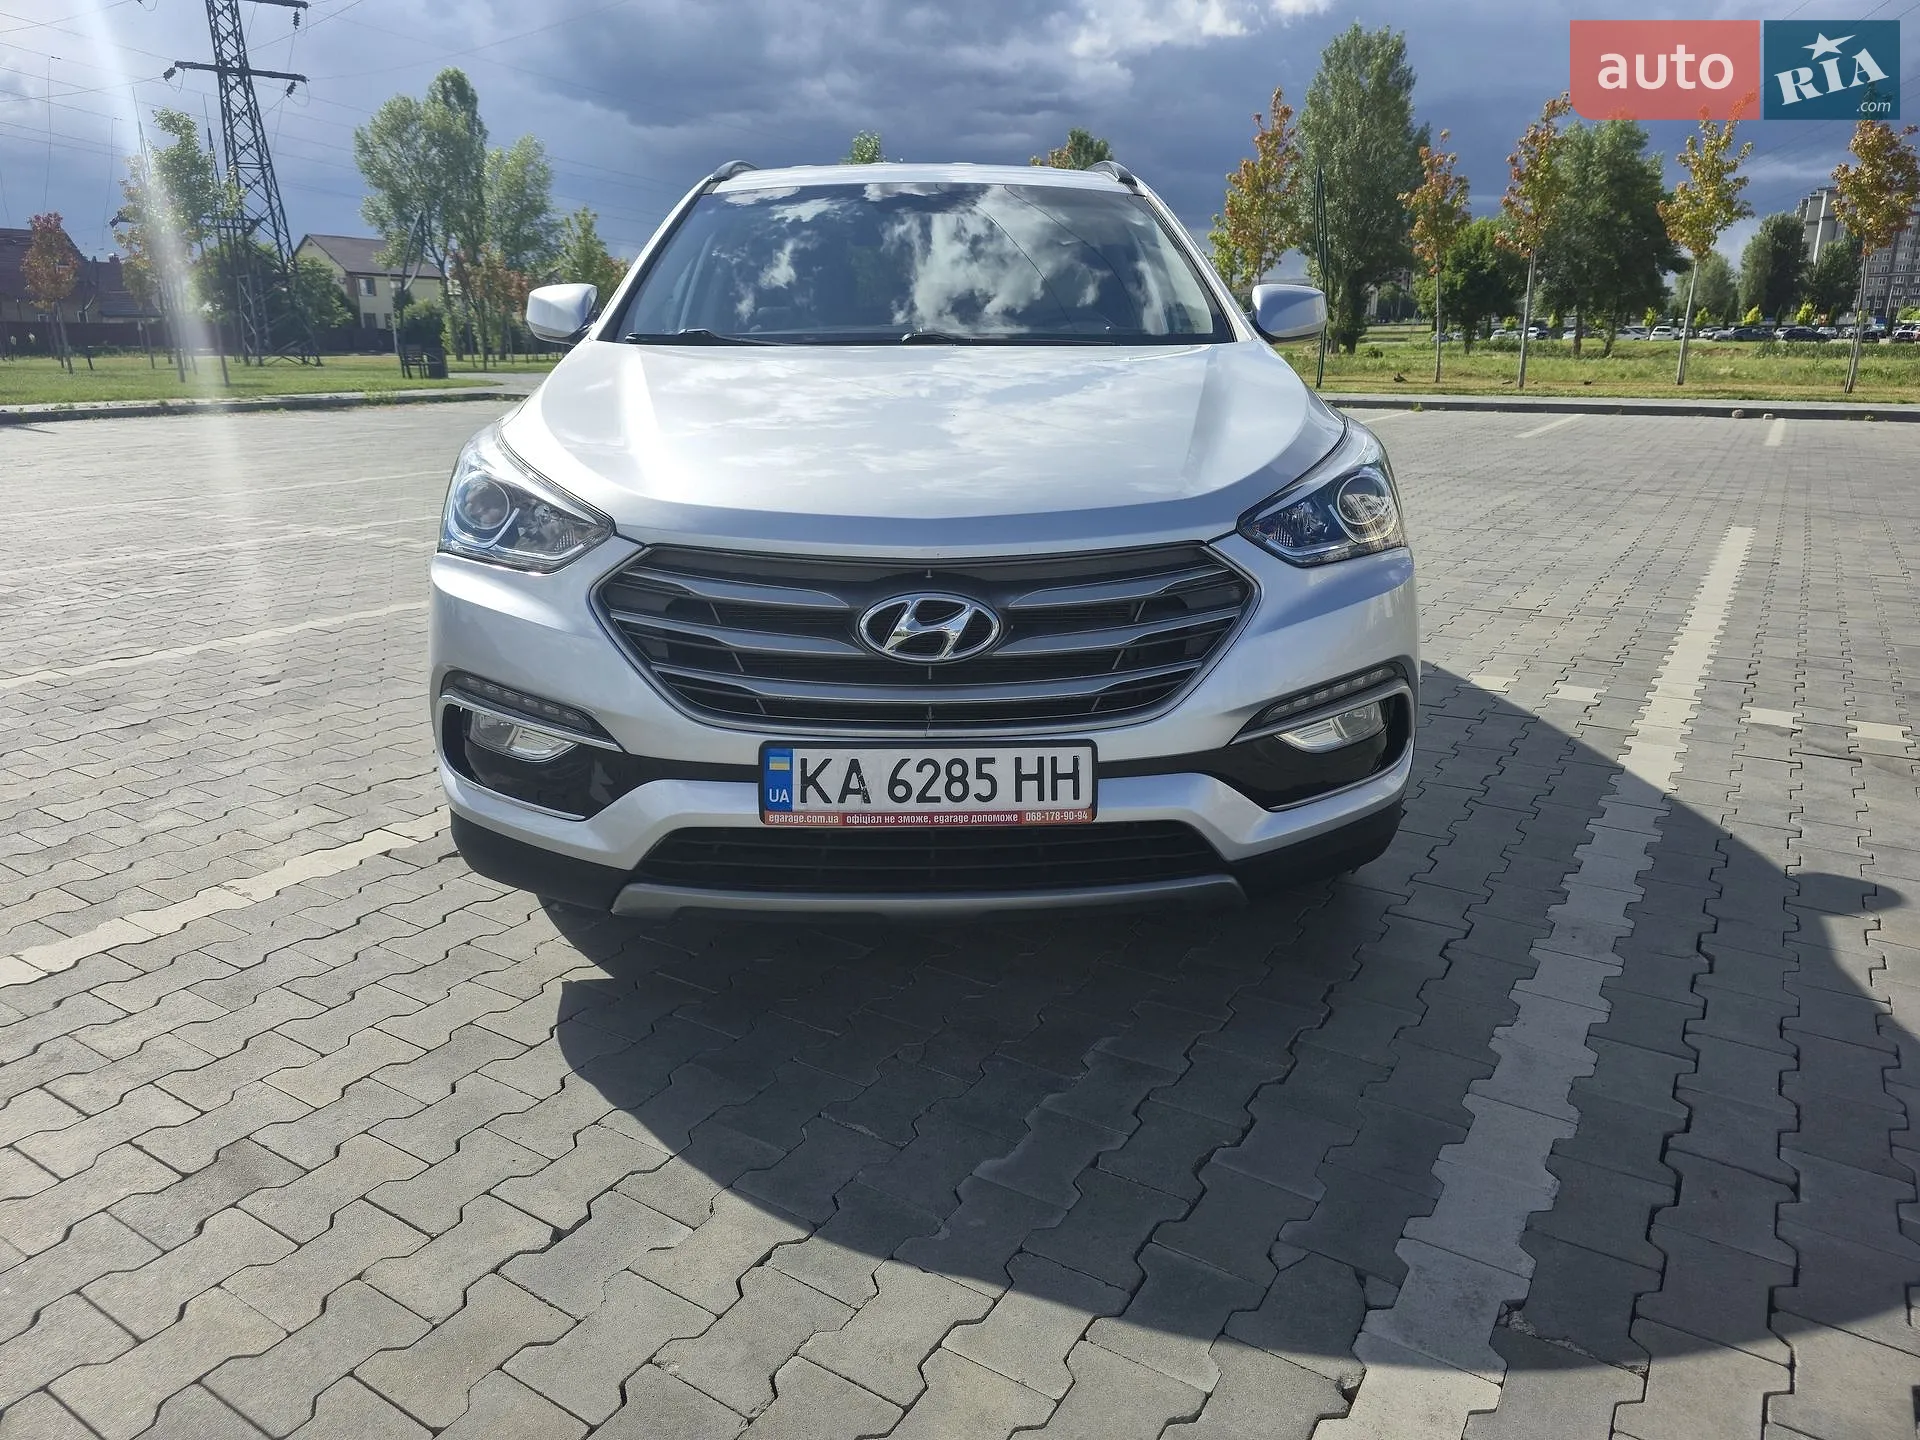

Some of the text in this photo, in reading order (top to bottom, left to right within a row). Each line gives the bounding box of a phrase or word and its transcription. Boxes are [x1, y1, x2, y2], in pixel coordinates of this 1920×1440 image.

[800, 755, 1080, 803] KA 6285 HH
[769, 789, 790, 803] UA
[768, 814, 839, 824] egarage.com.ua
[846, 813, 1018, 825] офіціал не зможе, egarage допоможе
[1025, 811, 1088, 821] 068-178-90-94
